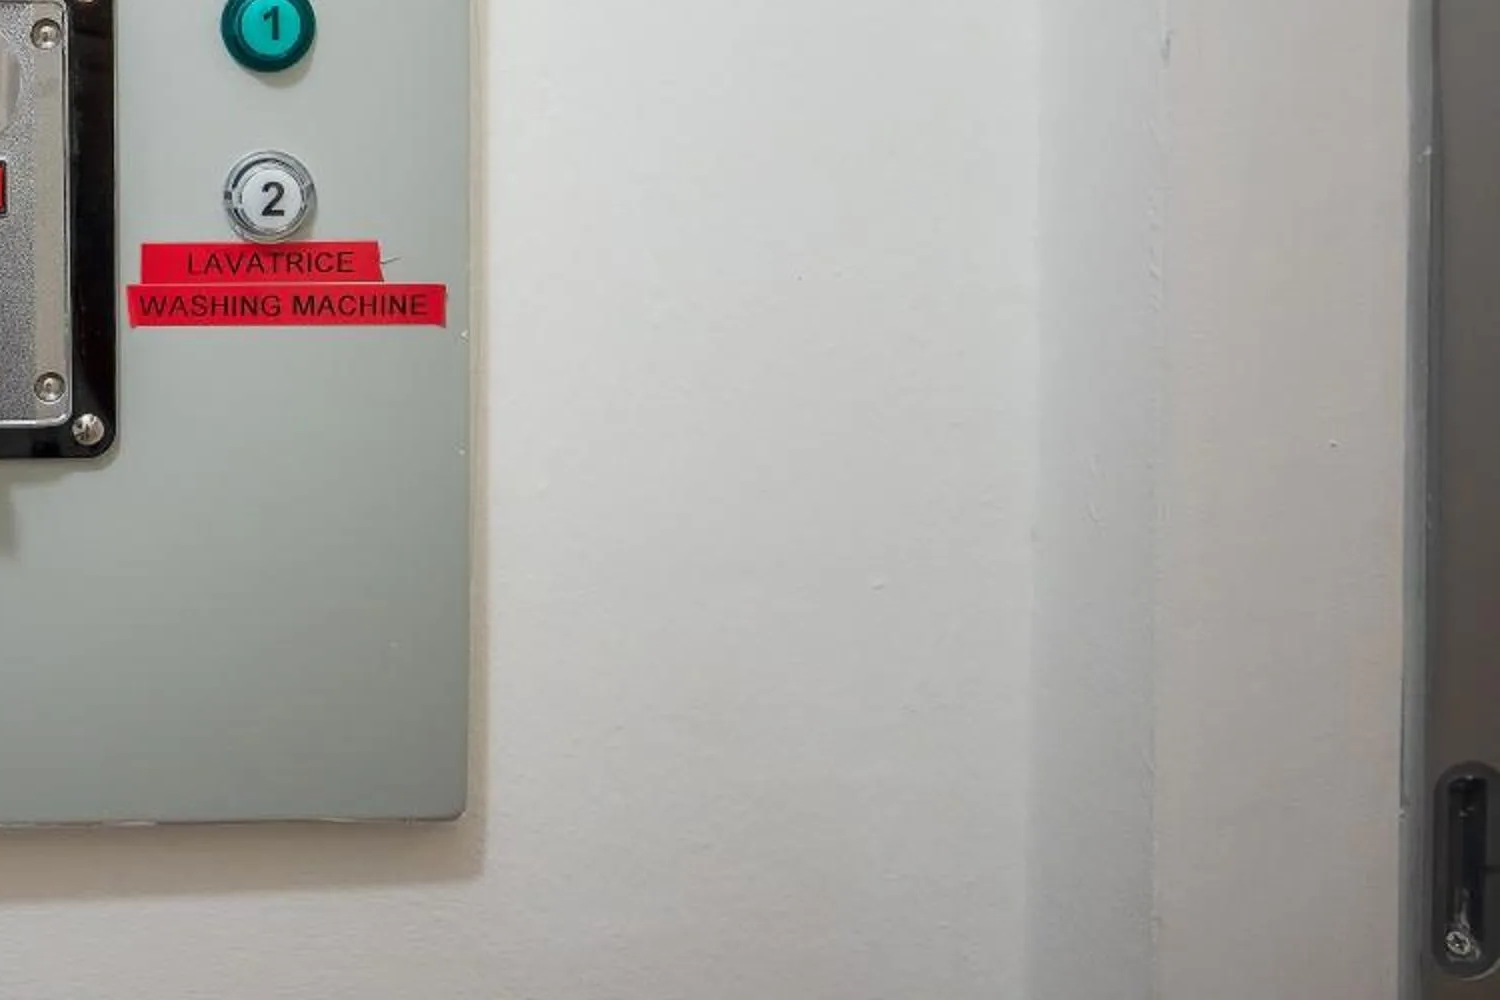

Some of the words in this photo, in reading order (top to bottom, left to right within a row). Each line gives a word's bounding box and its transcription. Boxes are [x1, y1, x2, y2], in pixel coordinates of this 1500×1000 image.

[262, 5, 281, 41] 1
[261, 181, 286, 217] 2
[187, 250, 356, 276] LAVATRICE
[139, 294, 282, 318] WASHING
[291, 294, 430, 318] MACHINE
